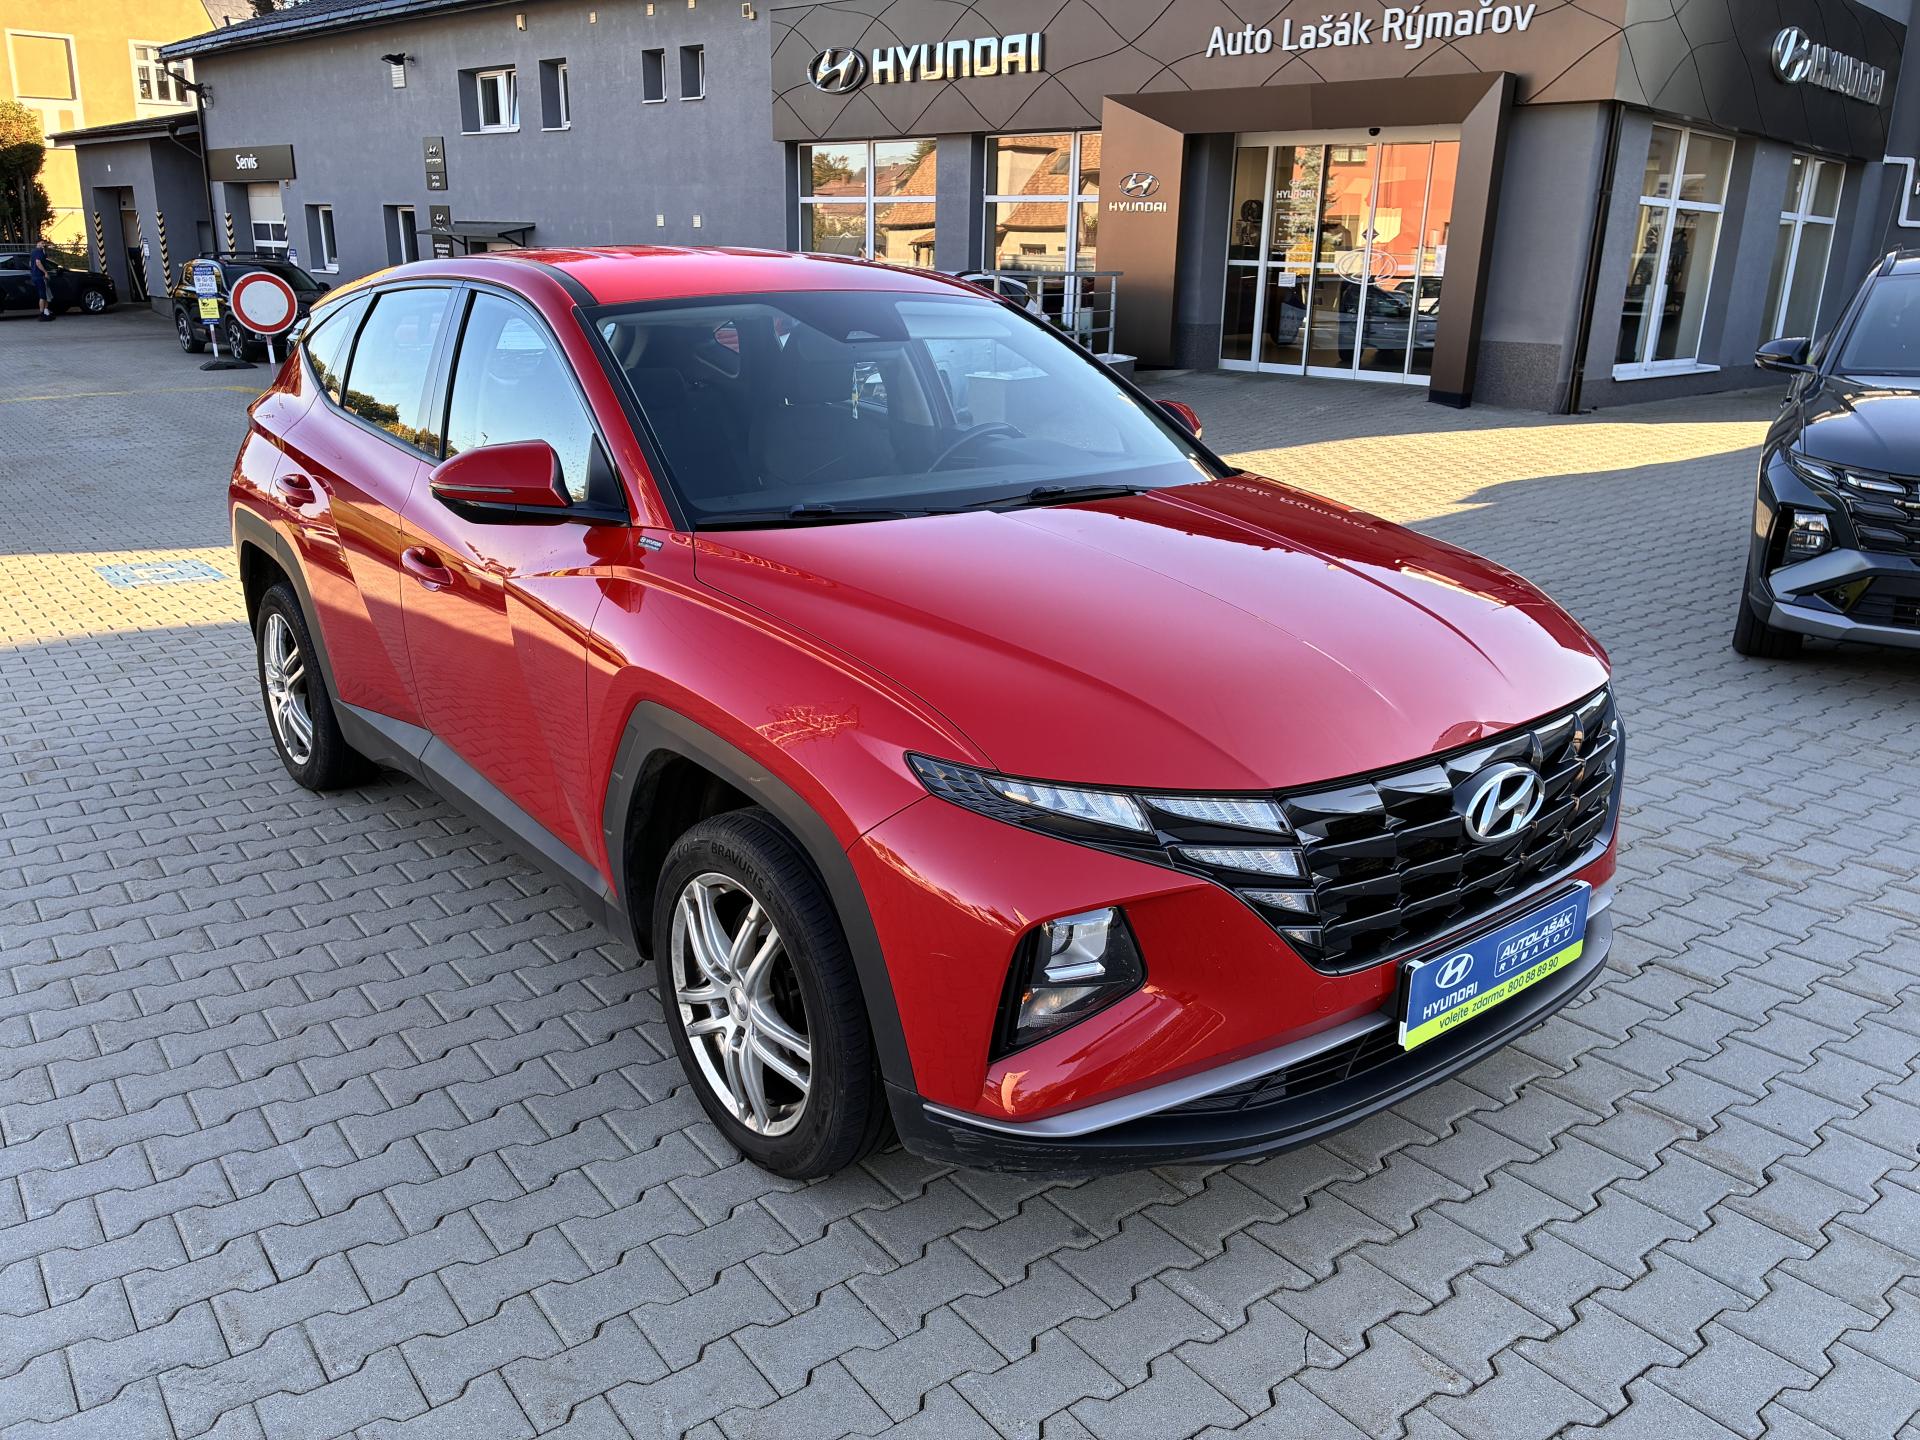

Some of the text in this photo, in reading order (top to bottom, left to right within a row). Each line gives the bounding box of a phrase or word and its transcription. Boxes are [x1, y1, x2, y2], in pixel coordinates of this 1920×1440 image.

[1205, 0, 1536, 58] Auto Lašák Rýmařov
[872, 32, 1044, 84] HYUNDAI
[1807, 43, 1885, 105] HYUNDAI
[235, 154, 258, 169] Servis
[1108, 201, 1167, 212] HYUNDAI
[711, 842, 765, 889] BRAVURIS
[1498, 927, 1571, 972] RÝMAŘOV
[1501, 912, 1573, 959] AUTOLAŠÁK
[1423, 981, 1478, 1020] HYUNDAI
[1439, 956, 1559, 1028] volejte zdarma 800 88 89 90
